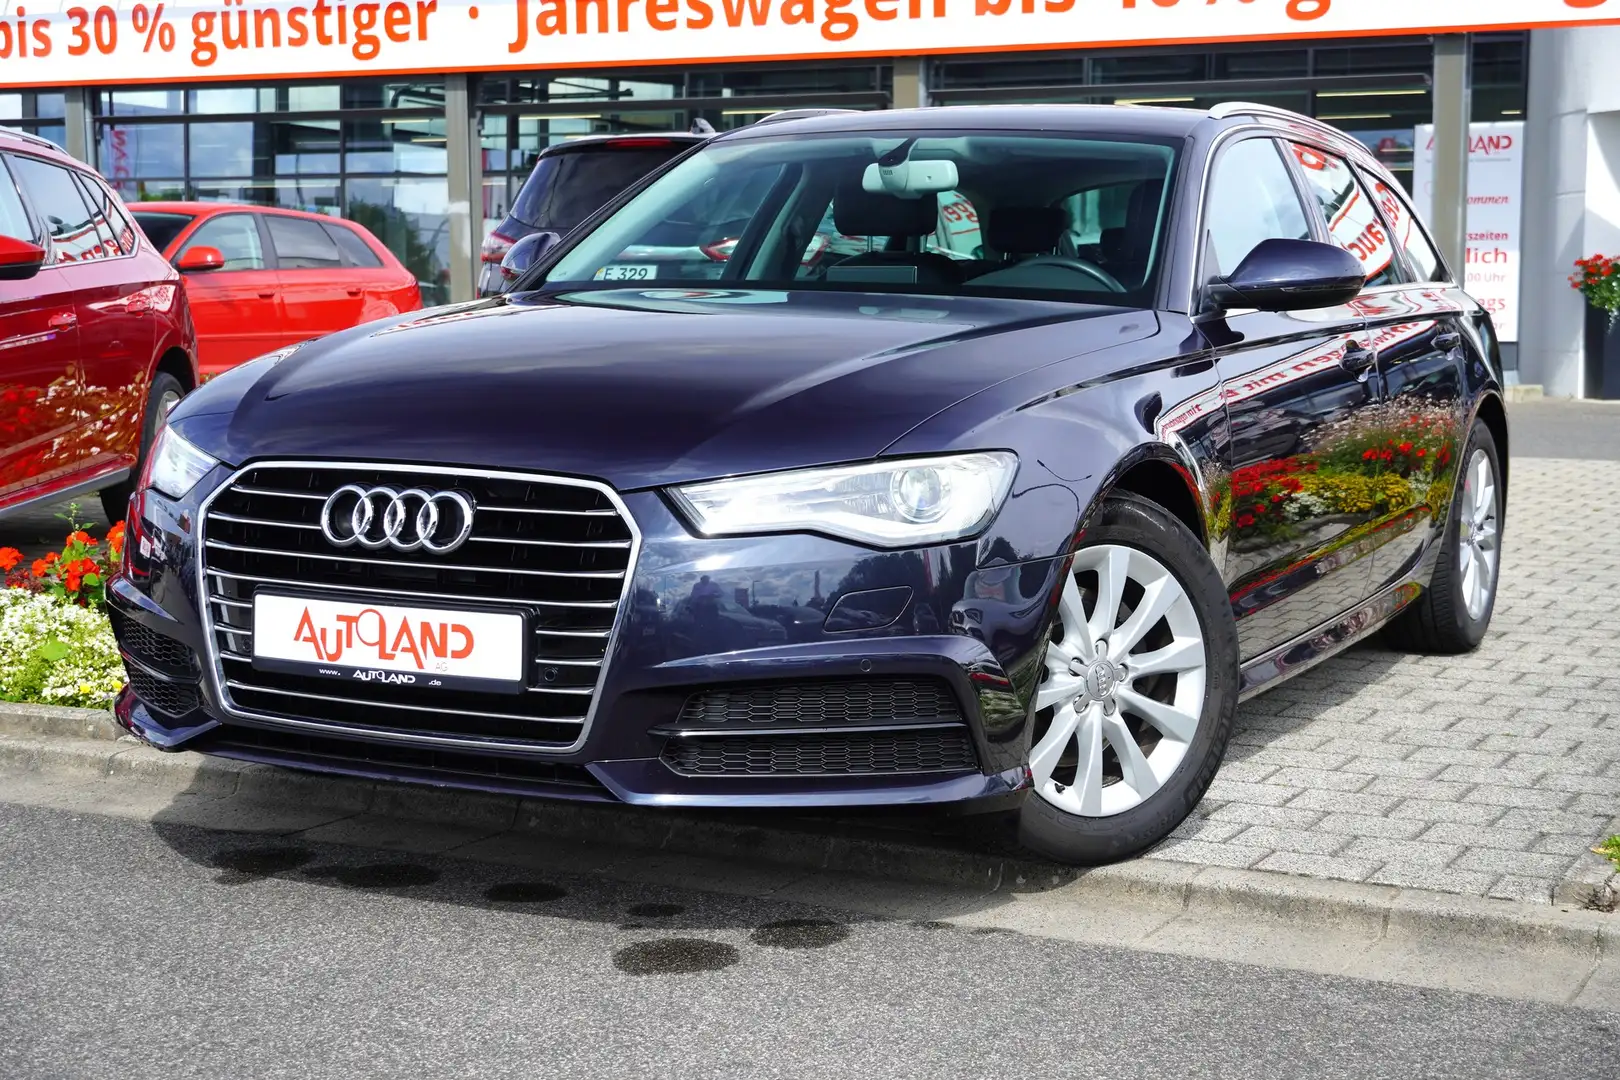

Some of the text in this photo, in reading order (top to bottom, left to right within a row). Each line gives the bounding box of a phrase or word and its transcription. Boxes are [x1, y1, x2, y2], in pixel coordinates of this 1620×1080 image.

[66, 5, 118, 56] 30
[132, 3, 175, 52] %
[191, 0, 437, 67] günstiger
[617, 267, 648, 280] 329
[1484, 272, 1506, 282] Uhr
[294, 606, 474, 669] AUTOLAND
[435, 661, 449, 672] AG
[353, 670, 416, 684] AUTOLAND
